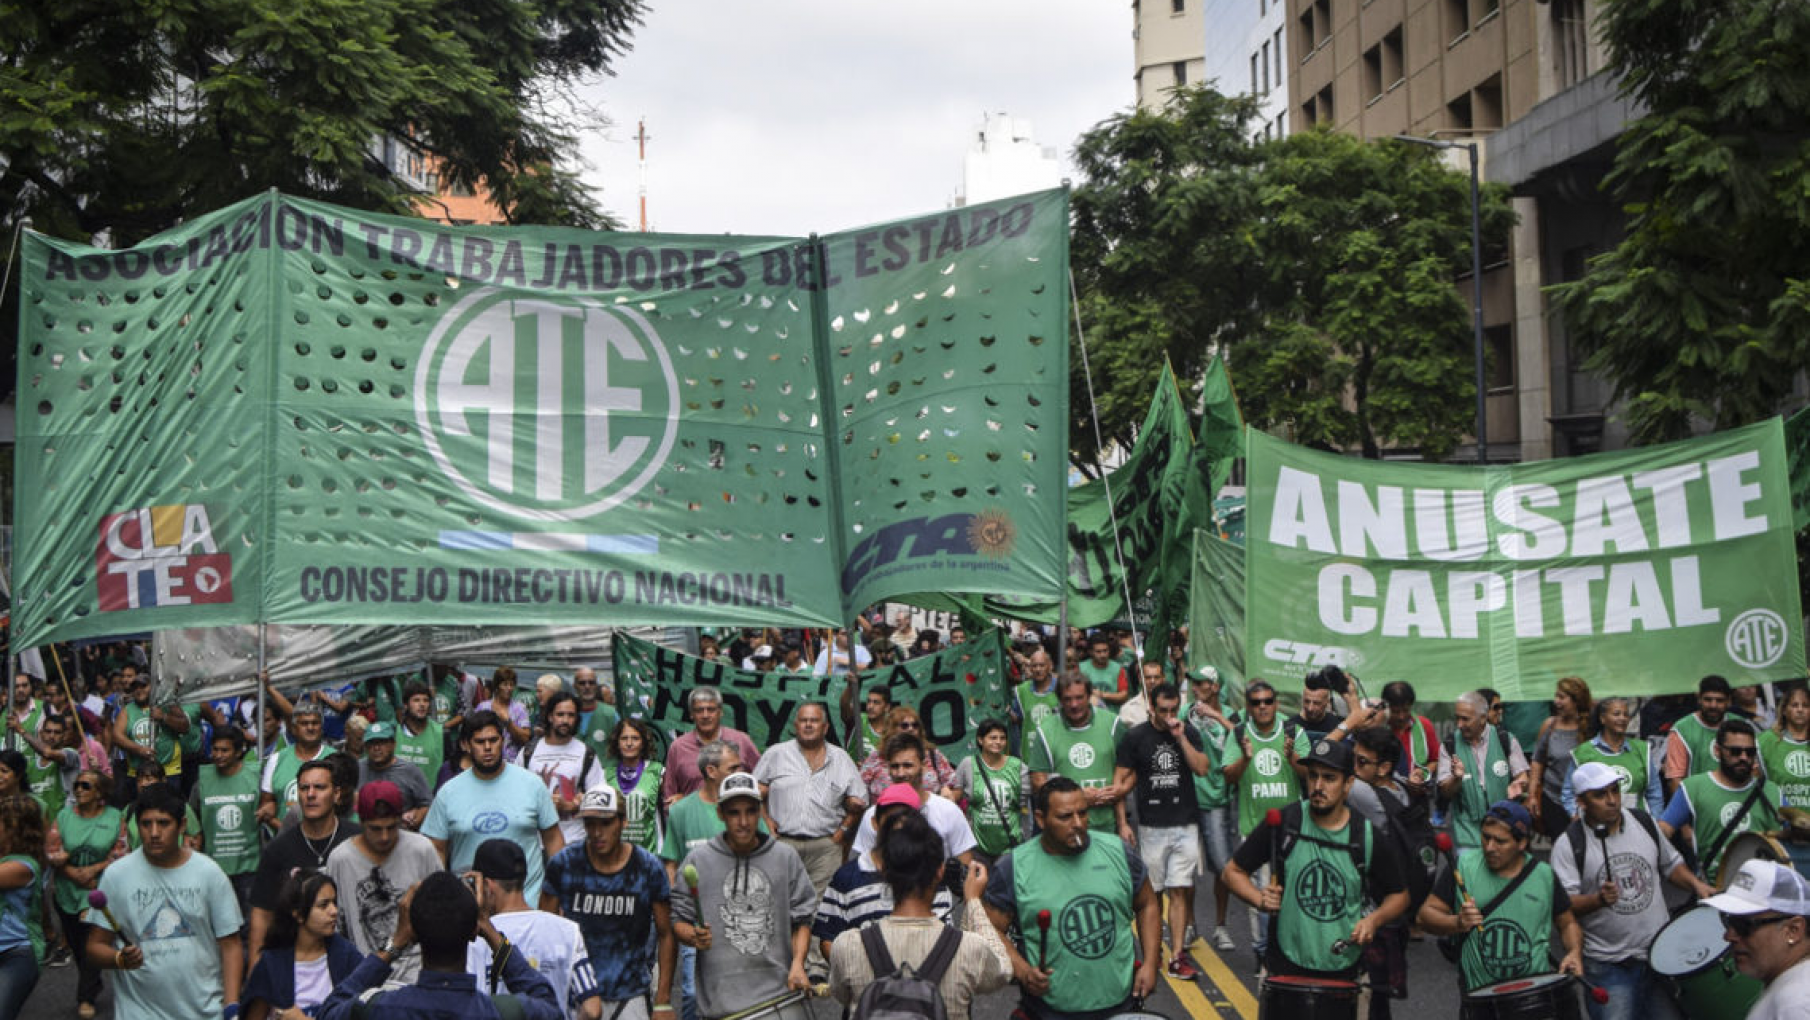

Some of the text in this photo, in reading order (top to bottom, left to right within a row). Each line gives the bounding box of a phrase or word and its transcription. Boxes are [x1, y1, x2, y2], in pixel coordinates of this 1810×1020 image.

[46, 201, 1034, 291] ASOCIACION TRABAJADORES DEL ESTADO
[438, 299, 650, 500] ATE
[1269, 450, 1768, 561] ANUSATE
[301, 566, 792, 608] CONSEJO DIRECTIVO NACIONAL
[1318, 555, 1720, 639] CAPITAL
[1734, 616, 1779, 662] ATE
[1252, 783, 1288, 799] PAMI
[572, 893, 634, 915] LONDON
